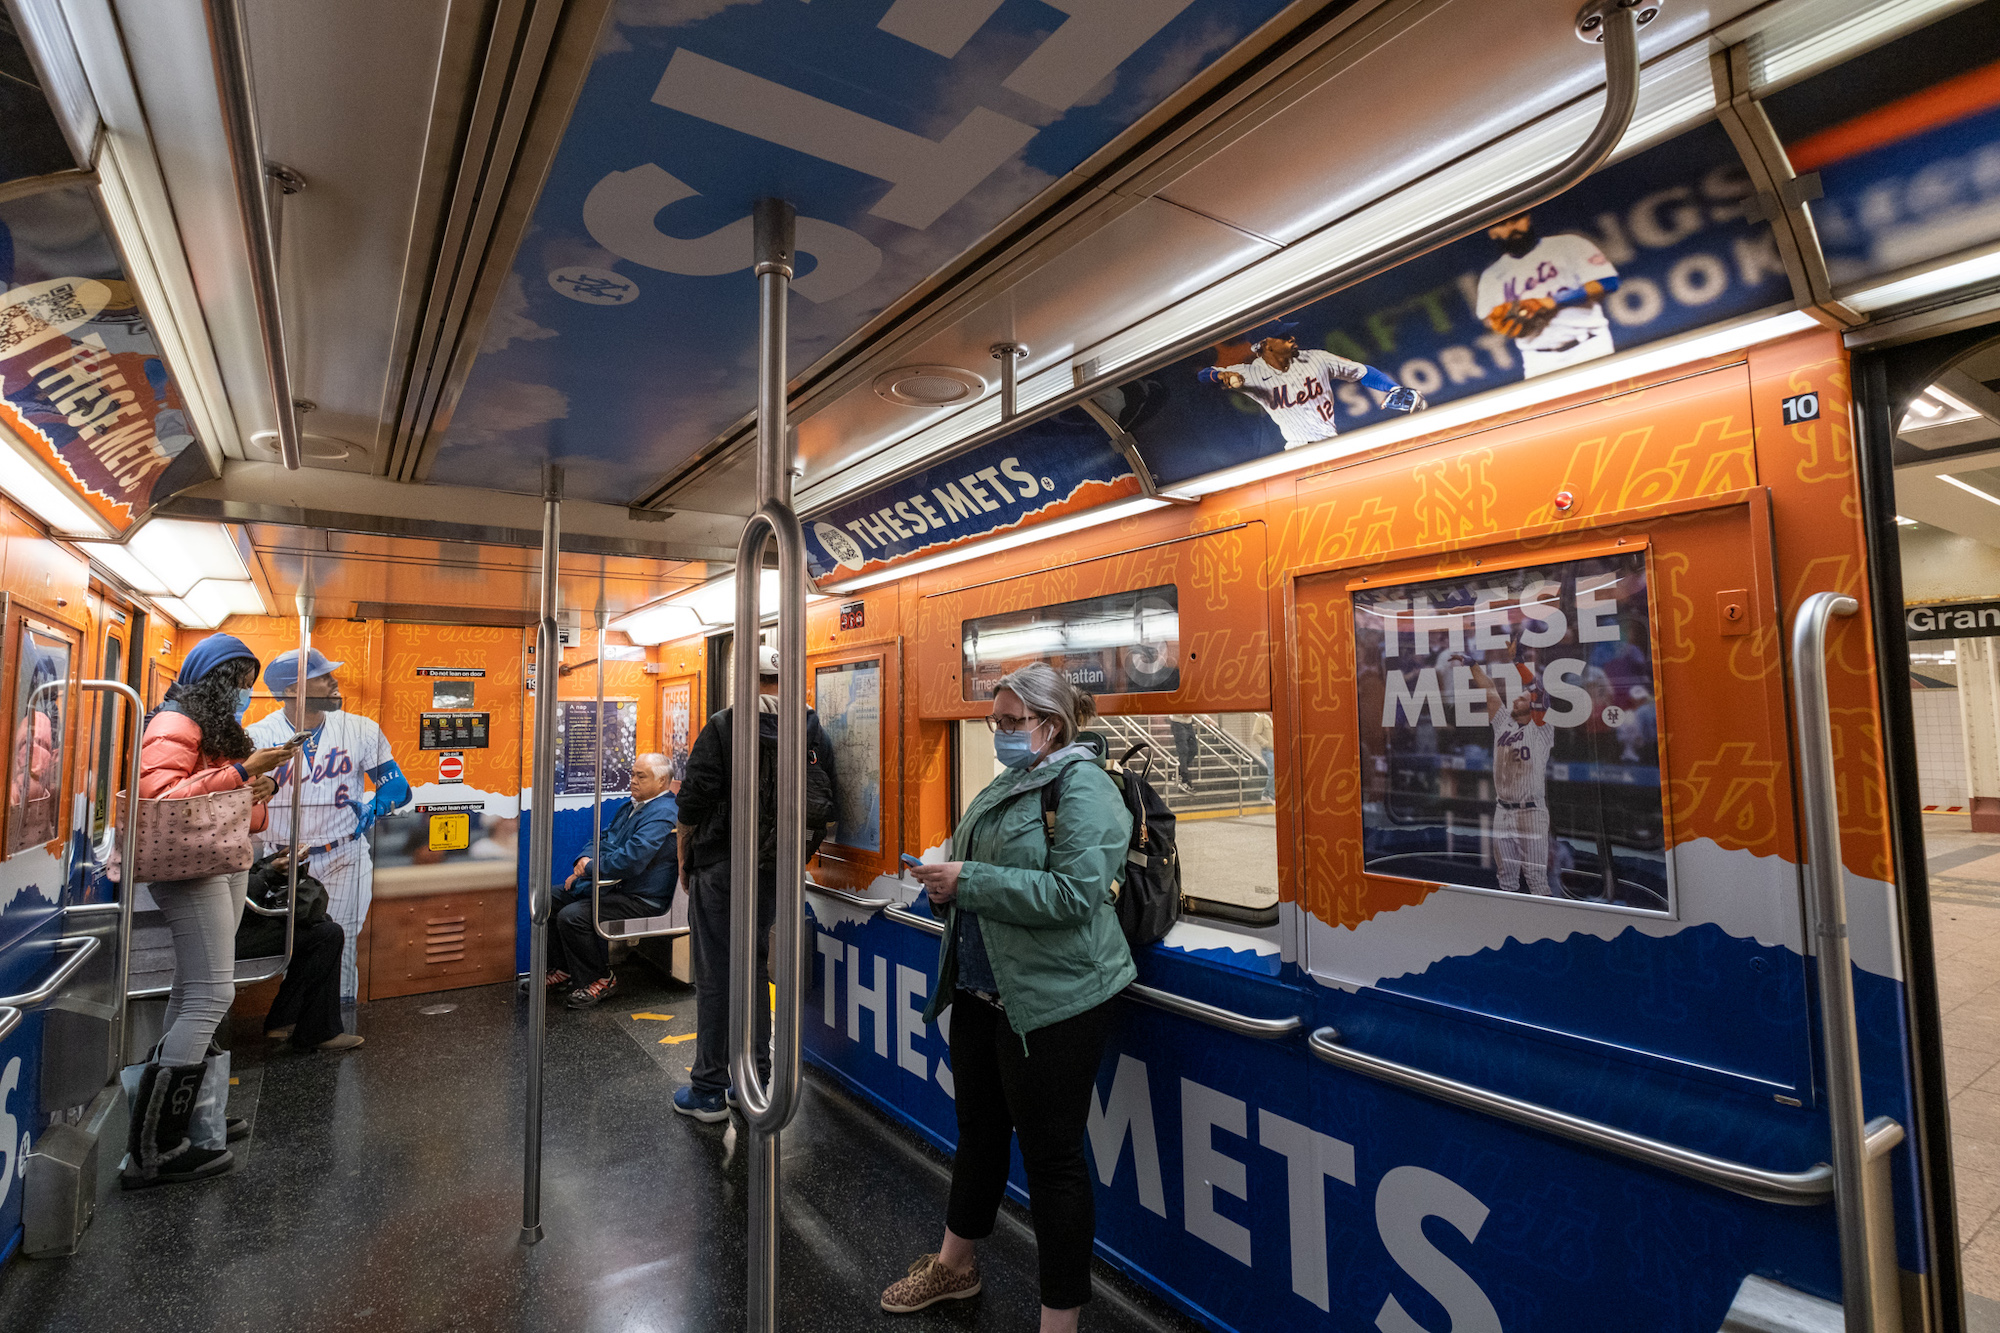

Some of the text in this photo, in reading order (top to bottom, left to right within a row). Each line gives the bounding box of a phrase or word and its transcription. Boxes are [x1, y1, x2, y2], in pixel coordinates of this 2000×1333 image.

[27, 331, 171, 488] THESE METS
[1270, 376, 1324, 411] Mets
[1316, 400, 1334, 422] 12
[1785, 395, 1819, 422] 10
[846, 494, 946, 550] THESE
[930, 457, 1039, 524] METS
[1373, 571, 1621, 657] THESE
[971, 668, 1103, 691] Times hattan
[1381, 657, 1593, 729] METS
[1512, 746, 1531, 763] 20
[334, 784, 350, 809] 6
[1088, 1052, 1505, 1333] METS
